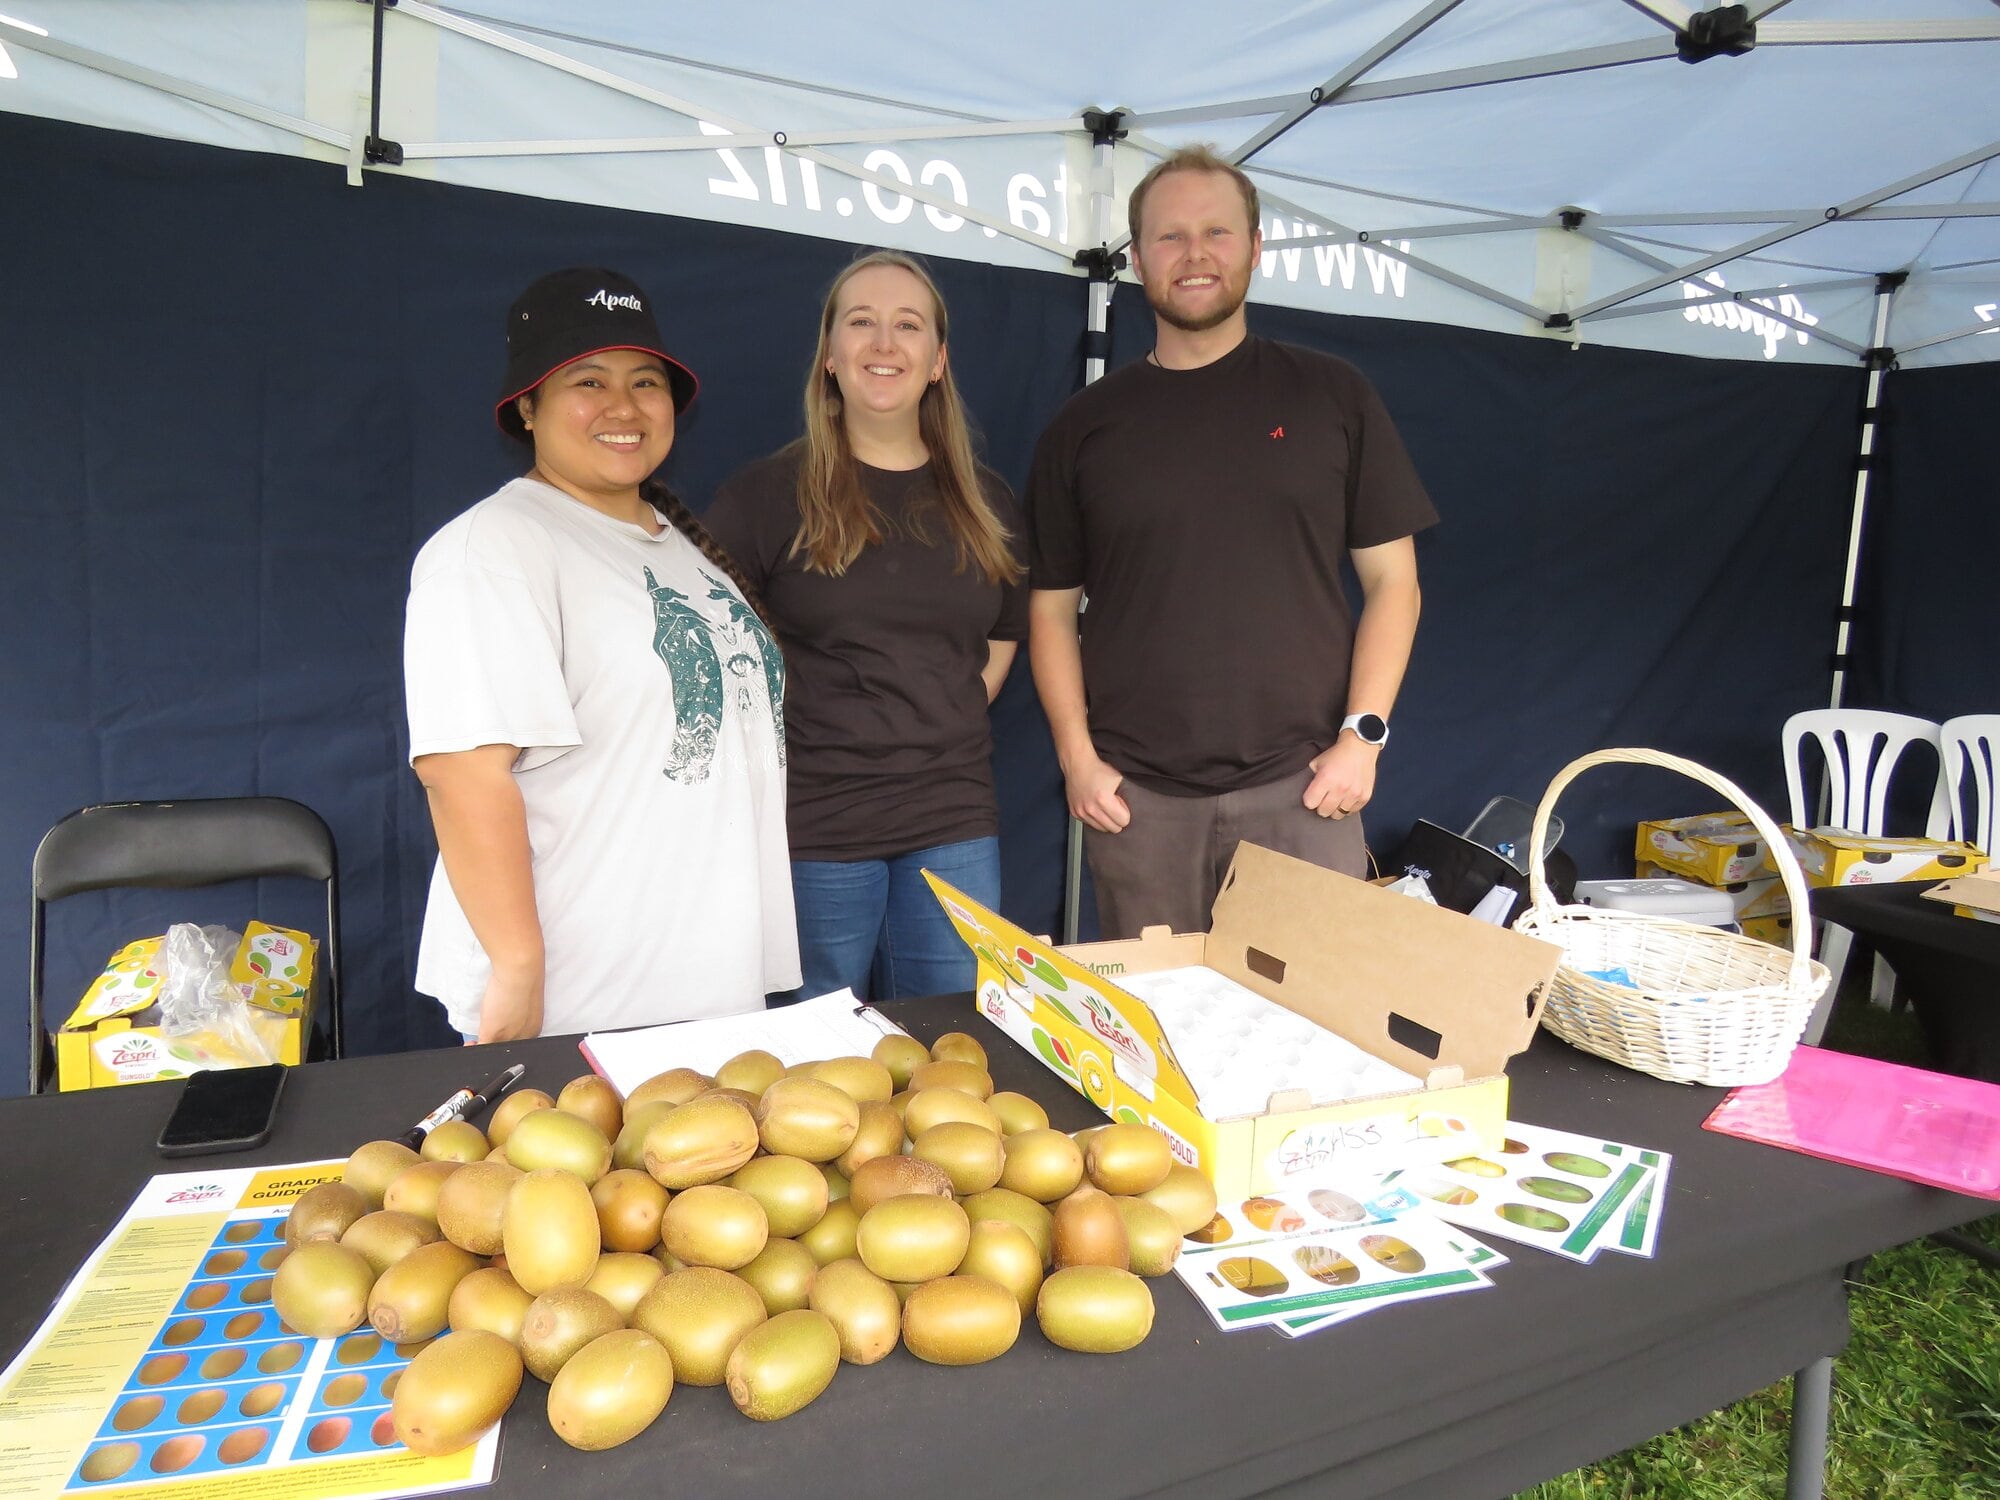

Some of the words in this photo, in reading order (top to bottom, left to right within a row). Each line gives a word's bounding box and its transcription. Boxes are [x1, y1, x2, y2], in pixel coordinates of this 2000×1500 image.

[585, 289, 642, 312] Apata
[986, 991, 1007, 1020] Zespri
[1080, 1000, 1143, 1060] Zespri
[111, 1049, 160, 1066] Zespri
[268, 1177, 322, 1190] GRADE
[165, 1189, 228, 1204] Zespri
